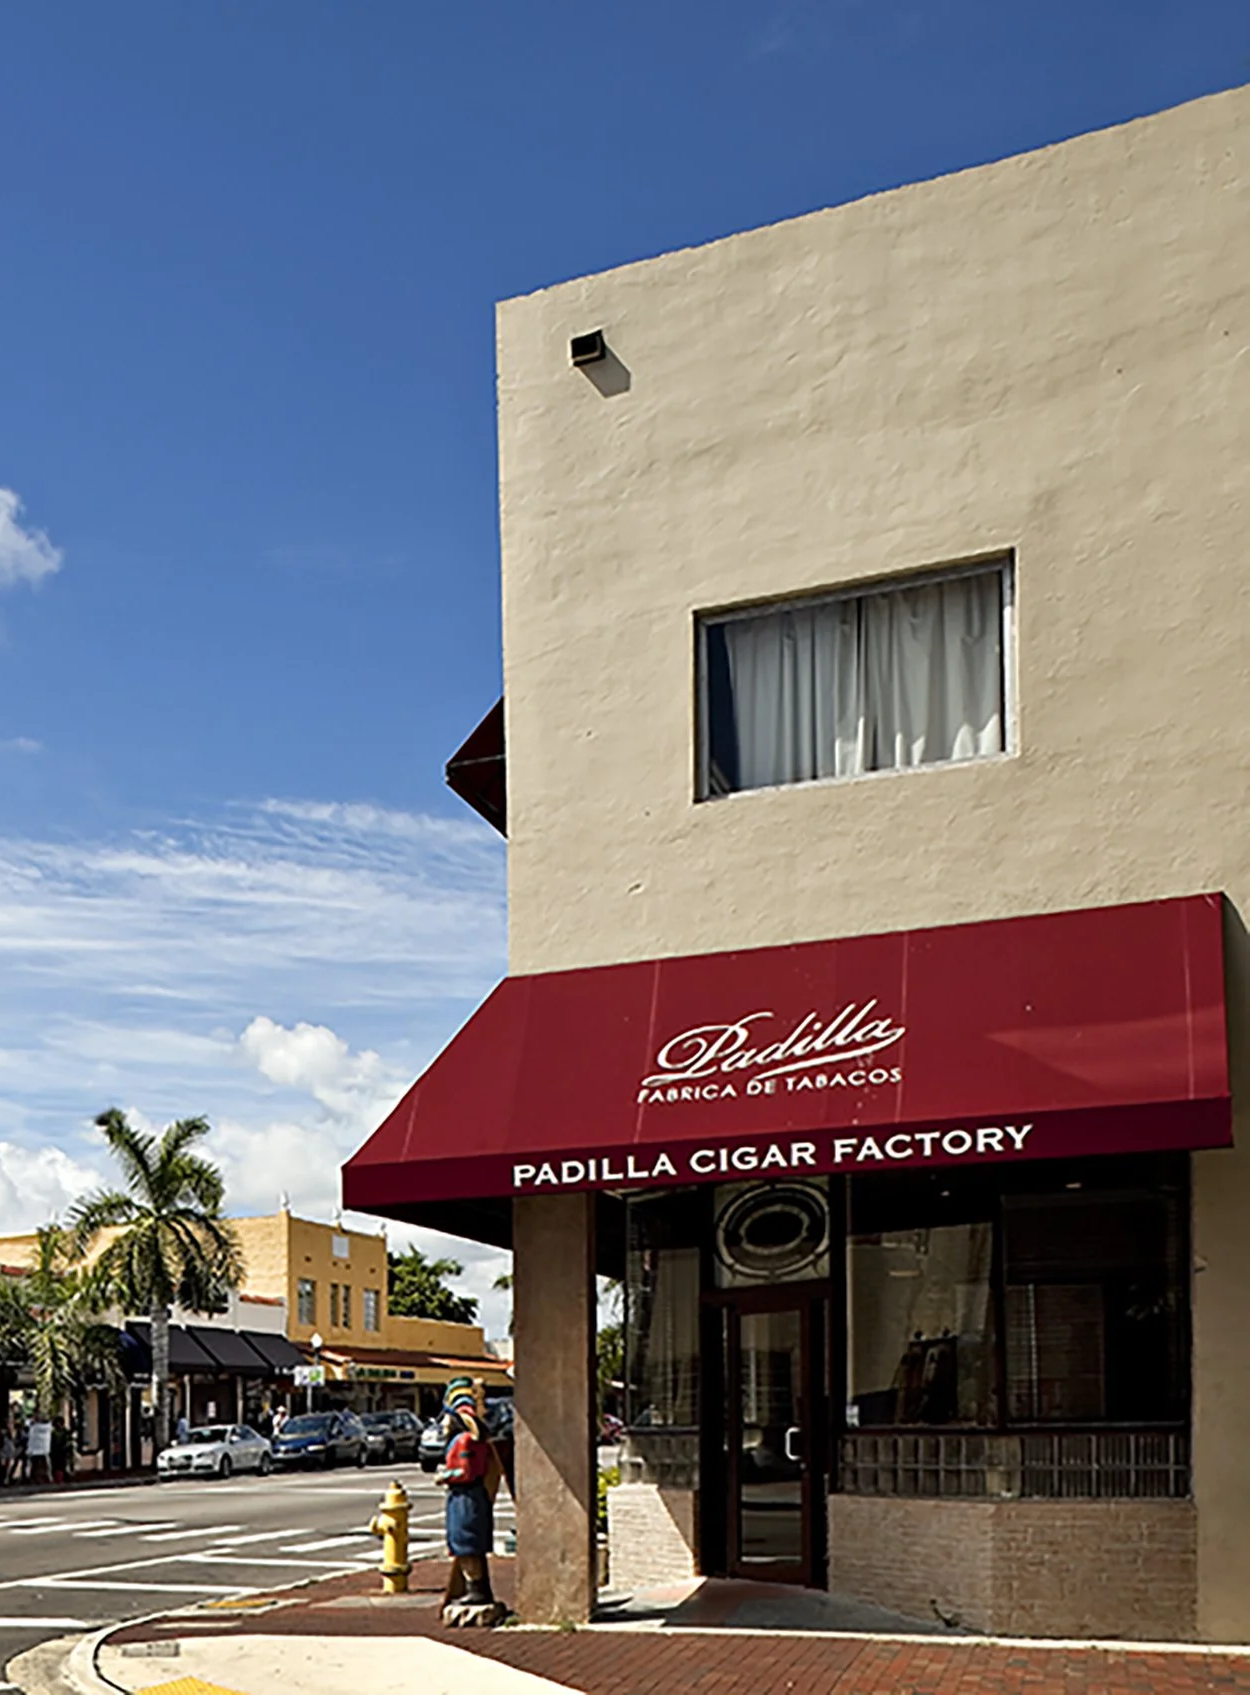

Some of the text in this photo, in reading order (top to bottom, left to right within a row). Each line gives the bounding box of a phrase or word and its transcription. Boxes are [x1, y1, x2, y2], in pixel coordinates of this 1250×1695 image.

[641, 999, 906, 1087] Padilla
[636, 1066, 903, 1104] FABRICA DE TABACOS
[512, 1123, 1035, 1188] PADILLA CIGAR FACTORY
